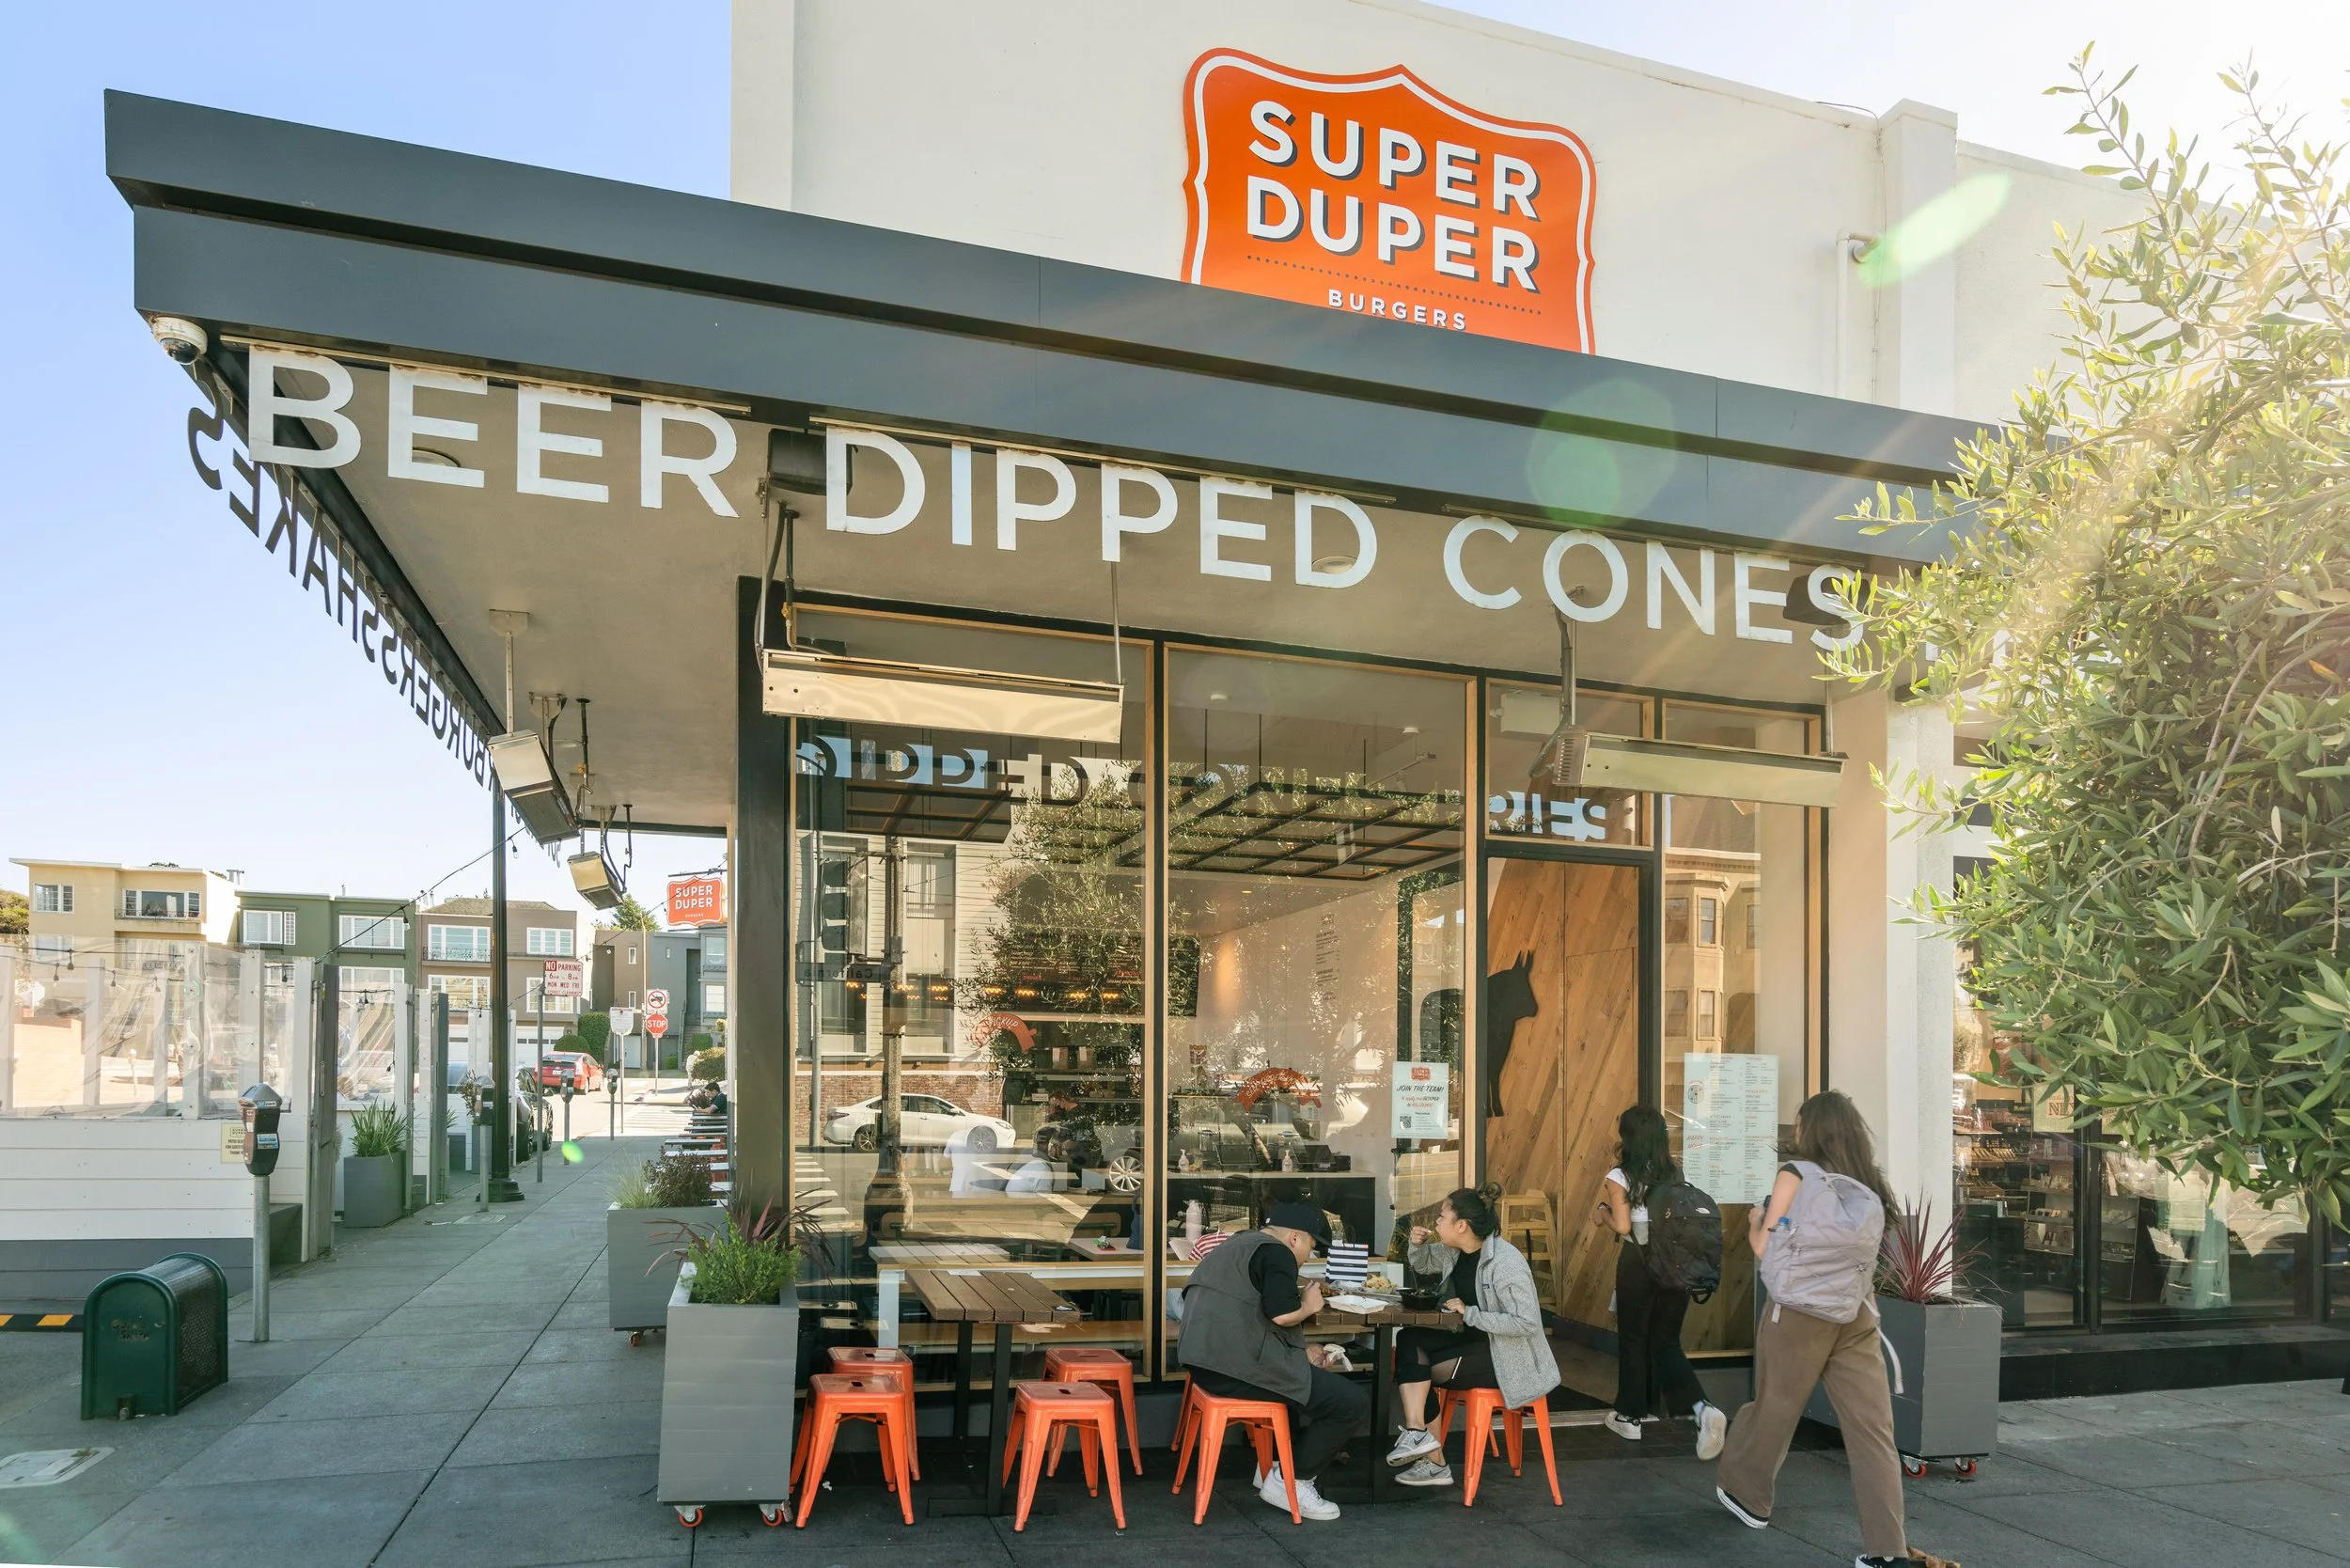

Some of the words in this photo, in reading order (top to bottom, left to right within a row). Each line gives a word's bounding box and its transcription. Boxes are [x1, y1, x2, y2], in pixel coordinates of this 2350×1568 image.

[1247, 100, 1539, 221] SUPER
[1246, 175, 1539, 291] DUPER
[1328, 289, 1466, 331] BURGERS
[248, 343, 740, 519] BEER
[825, 424, 1378, 590] DIPPED
[1442, 514, 1865, 652] CONES
[675, 885, 713, 898] SUPER
[675, 897, 713, 910] DUPER
[545, 961, 556, 971] NO
[558, 964, 581, 972] PARKING
[647, 1019, 666, 1028] STOP
